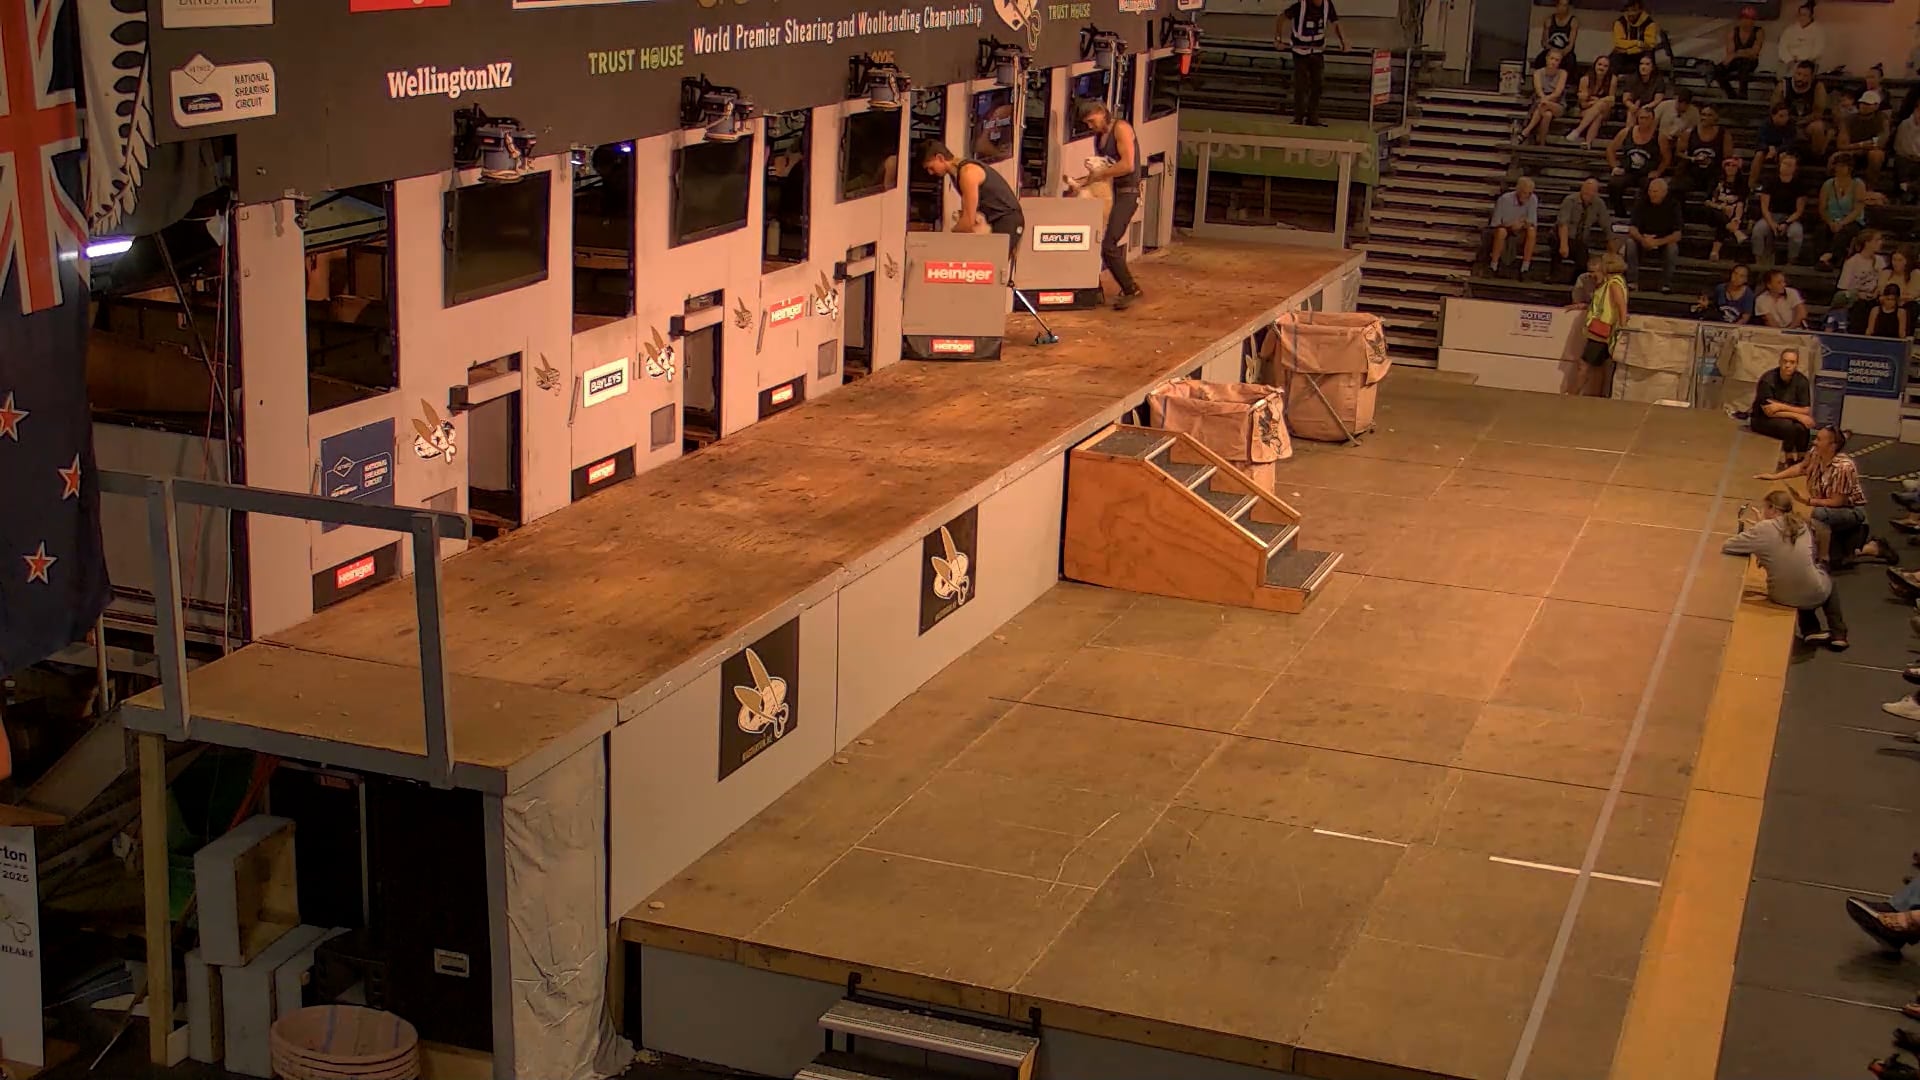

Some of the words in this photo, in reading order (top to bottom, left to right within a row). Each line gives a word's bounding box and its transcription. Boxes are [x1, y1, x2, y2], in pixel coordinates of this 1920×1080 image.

[693, 25, 731, 54] World
[736, 21, 781, 50] Premier
[784, 16, 834, 44] Shearing
[836, 13, 856, 38] and
[858, 8, 921, 34] Woolhandling
[923, 3, 983, 30] Championship
[588, 49, 636, 75] TRUST
[640, 44, 685, 69] HOUSE
[234, 72, 270, 84] NATIONAL
[387, 62, 513, 99] WellingtonNZ
[234, 84, 270, 97] SHEARING
[235, 97, 263, 110] CIRCUIT
[1042, 234, 1081, 242] BAYLEYS
[927, 262, 993, 283] Heiniger
[1520, 310, 1551, 321] NOTICE
[1849, 359, 1890, 369] NATIONAL
[590, 372, 622, 392] BAYLEYS
[1848, 375, 1881, 385] CIRCUIT
[2, 870, 30, 883] 2025
